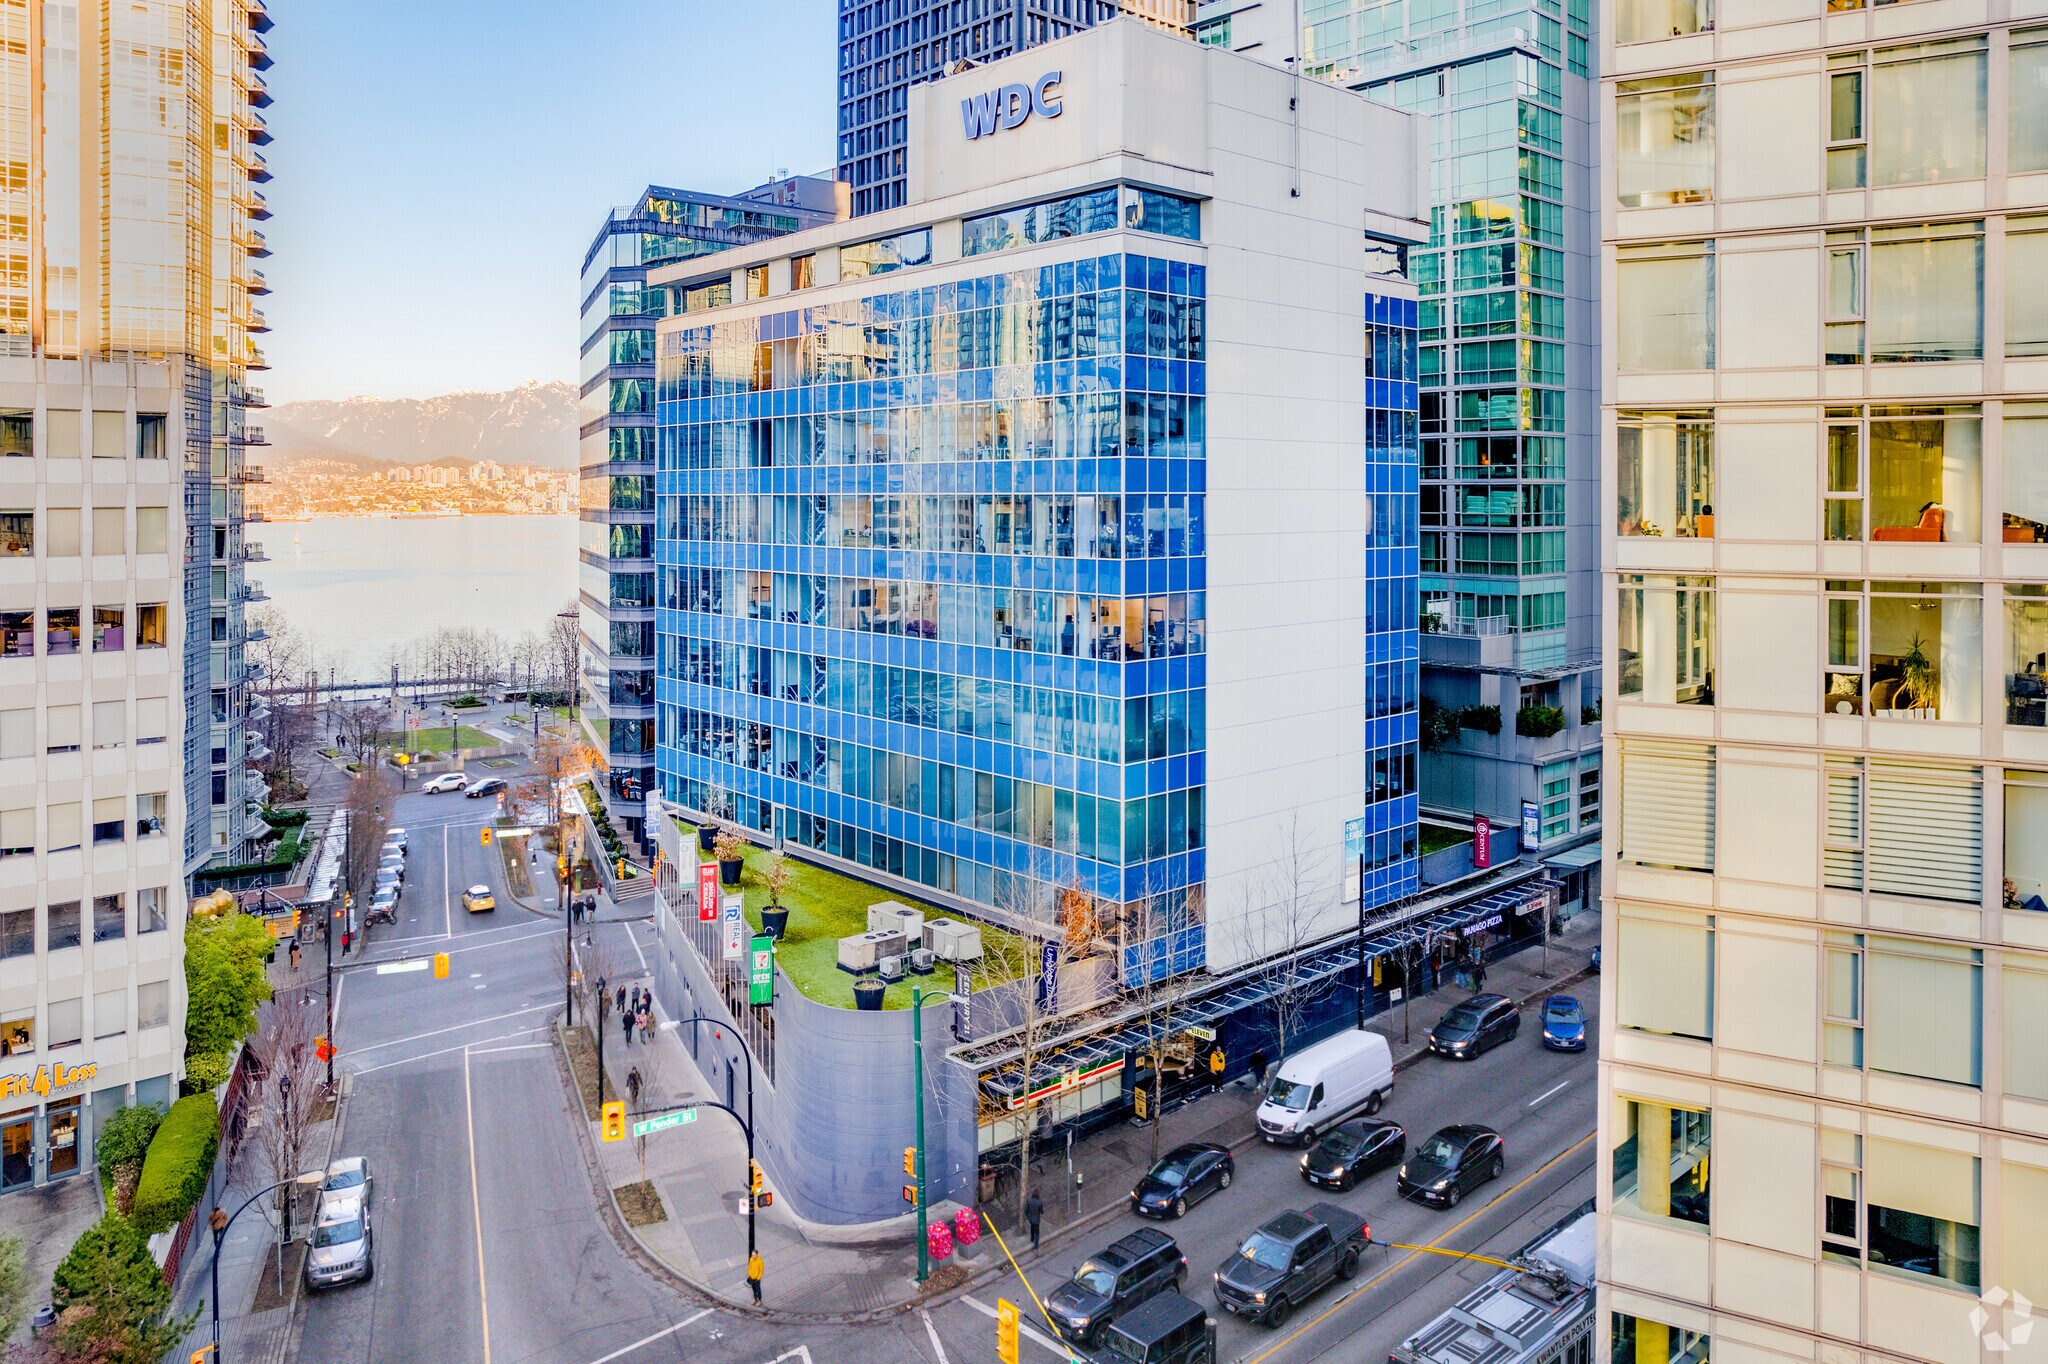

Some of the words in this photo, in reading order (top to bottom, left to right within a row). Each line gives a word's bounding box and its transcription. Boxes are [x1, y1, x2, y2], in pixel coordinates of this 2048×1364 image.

[961, 70, 1062, 140] WDC
[1346, 822, 1358, 831] FOR
[1346, 829, 1363, 841] LEASE
[733, 922, 741, 941] REAL
[1464, 920, 1486, 936] PANAGO
[1487, 914, 1503, 928] PIZZA
[963, 974, 971, 1021] CENTURY
[0, 1073, 28, 1099] Fit
[31, 1064, 51, 1097] 4
[53, 1062, 97, 1087] Less
[638, 1122, 647, 1132] W
[650, 1116, 679, 1130] Pender
[682, 1111, 692, 1121] St
[1536, 1333, 1571, 1364] KWANTLEN
